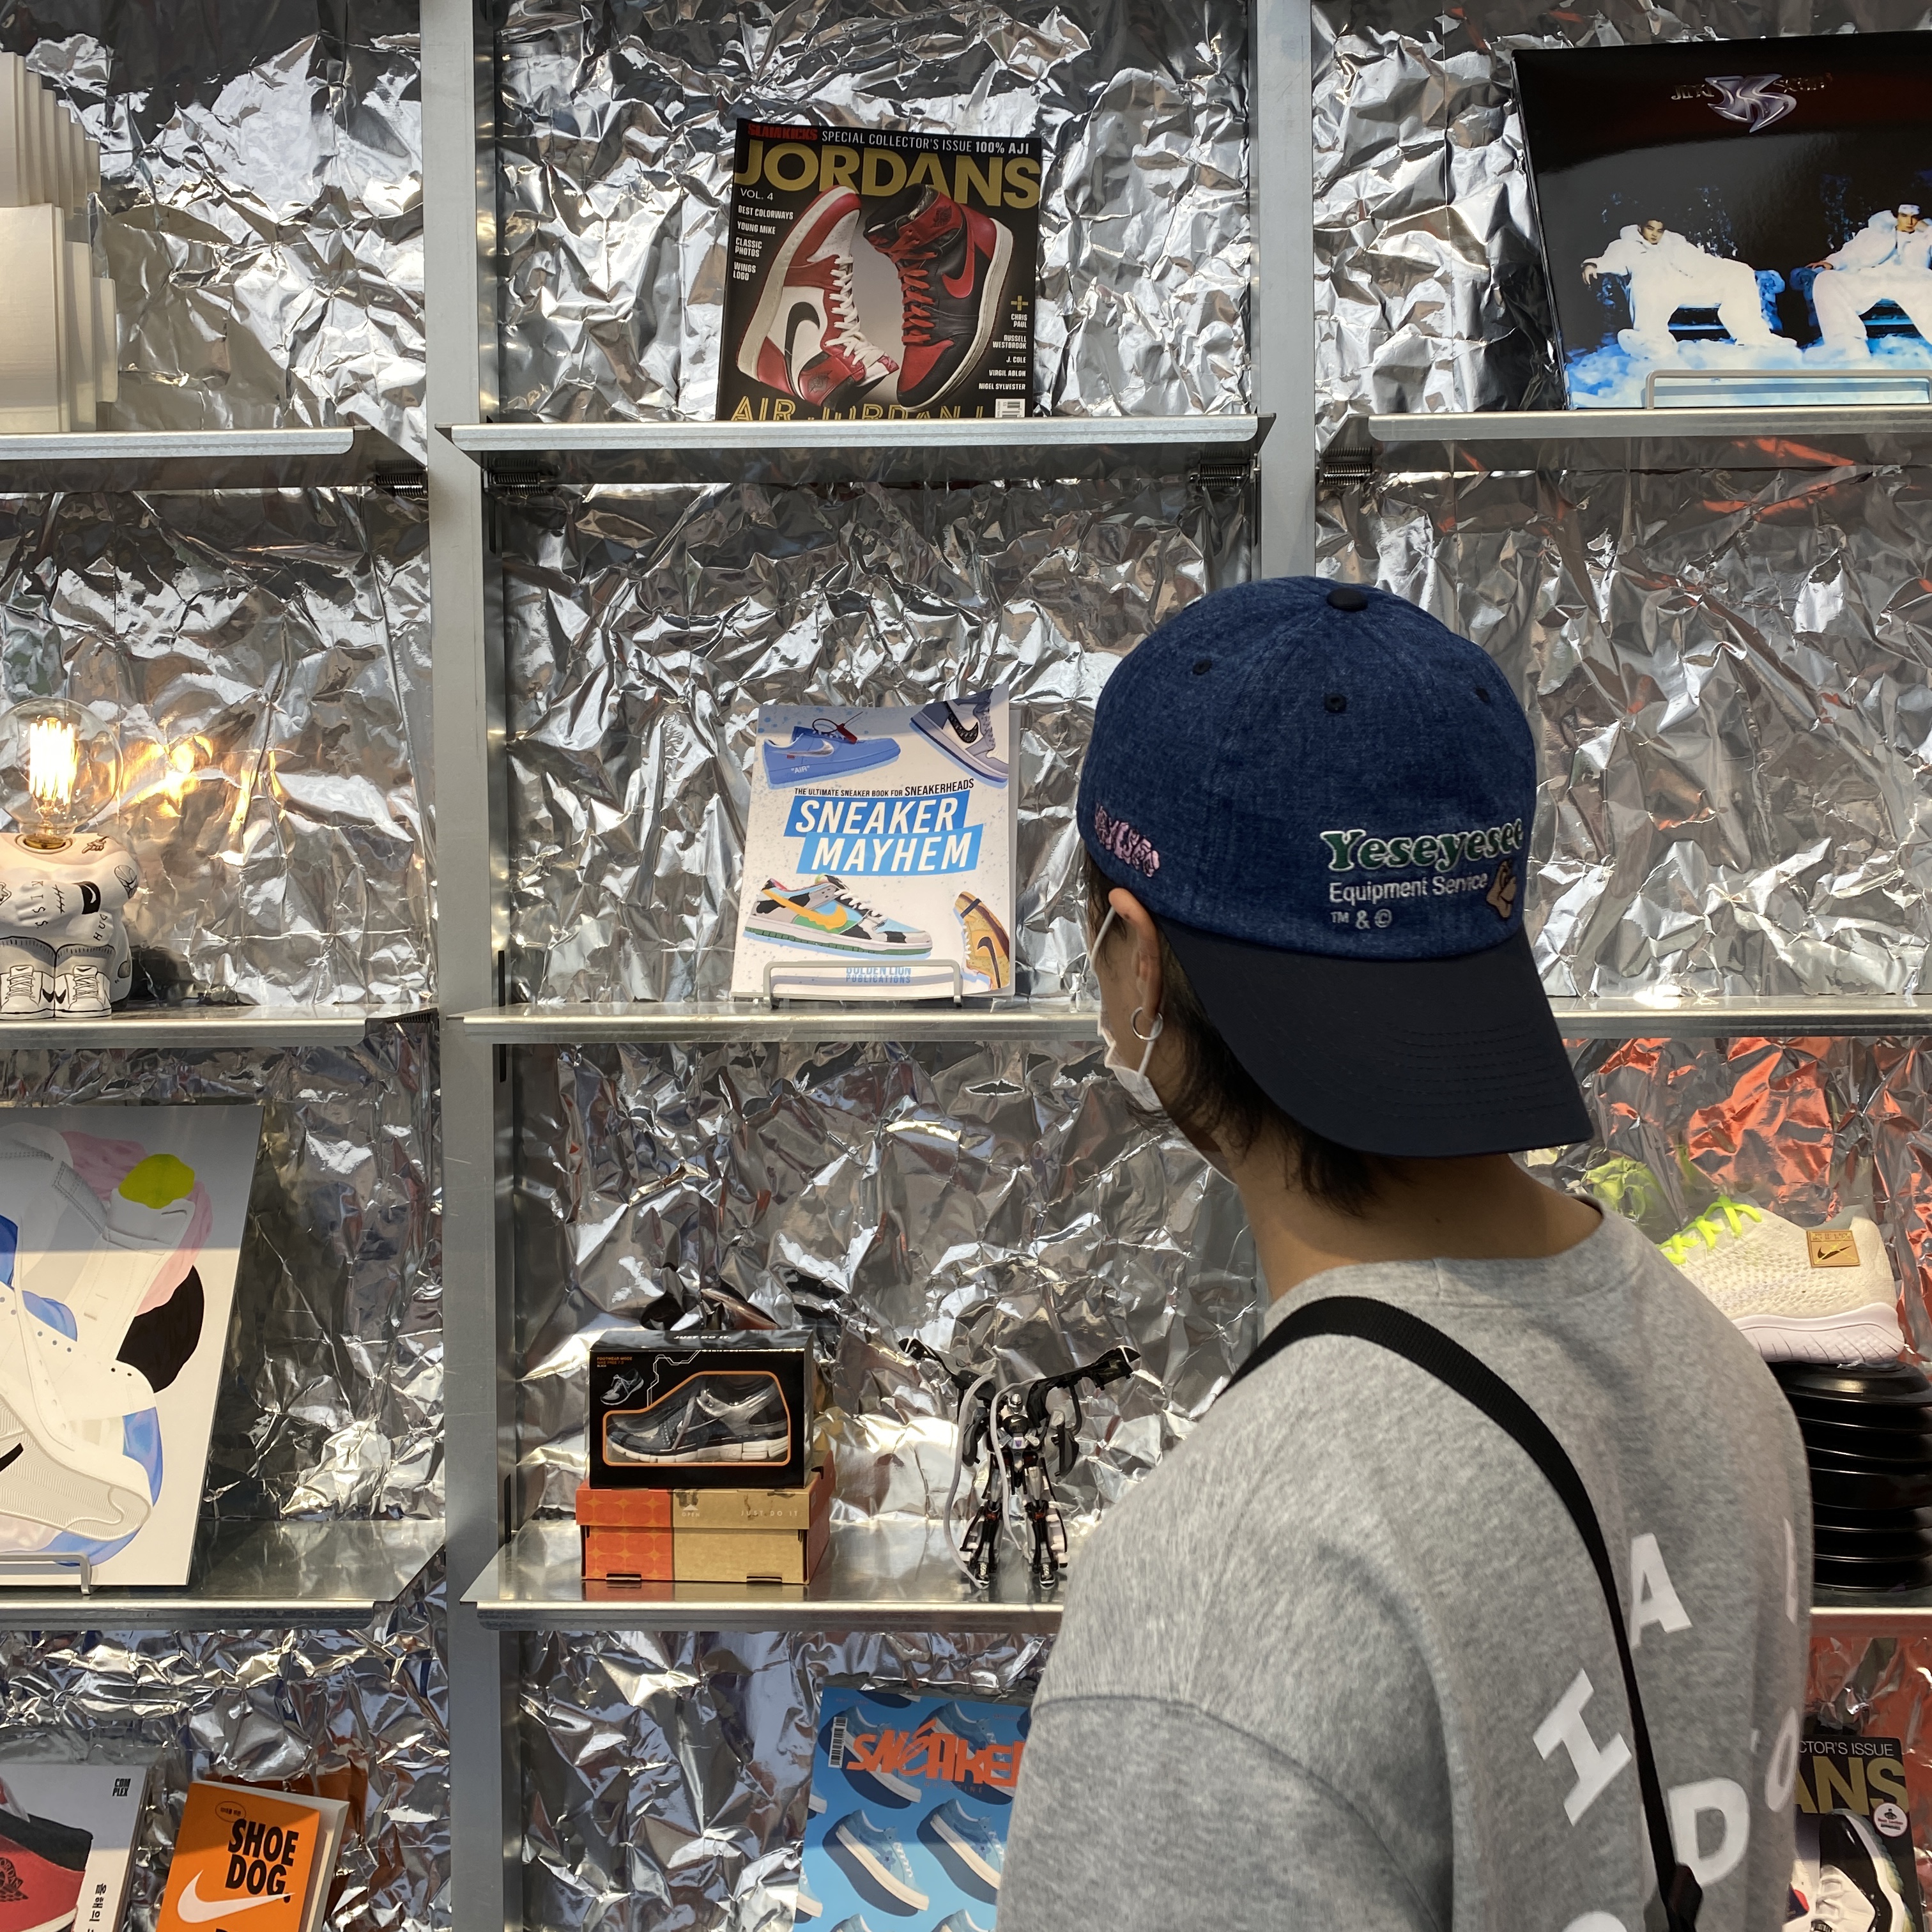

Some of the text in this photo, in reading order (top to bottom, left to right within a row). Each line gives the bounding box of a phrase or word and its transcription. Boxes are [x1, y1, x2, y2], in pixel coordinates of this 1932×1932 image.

[822, 130, 865, 144] SPECIAL
[869, 134, 939, 150] COLLECTOR'S
[942, 139, 972, 152] ISSUE
[976, 141, 1005, 154] 100%
[734, 139, 1041, 209] JORDANS
[740, 187, 774, 201] VOL. 4
[738, 205, 793, 220] BEST COLORWAYS
[737, 220, 776, 234] YOUNG MIKE
[735, 237, 762, 249] CLASSIC
[735, 245, 760, 257] PHOTOS
[733, 261, 756, 273] WINGS
[733, 270, 749, 281] LOGO
[1011, 313, 1028, 321] CHRIS
[992, 341, 1027, 349] WESTBROOK
[1004, 334, 1027, 342] RUSSELL
[808, 788, 839, 797] ULTIMATE
[905, 778, 974, 797] SNEAKERHEADS
[795, 797, 958, 834] SNEAKER
[811, 831, 972, 872] MAYHEM
[1329, 873, 1489, 907] Equipment Service
[1356, 910, 1370, 930] &
[845, 974, 911, 984] PUBLICATIONS
[1851, 1743, 1894, 1756] ISSUE
[112, 1787, 129, 1797] PLEX
[227, 1818, 299, 1867] SHOE
